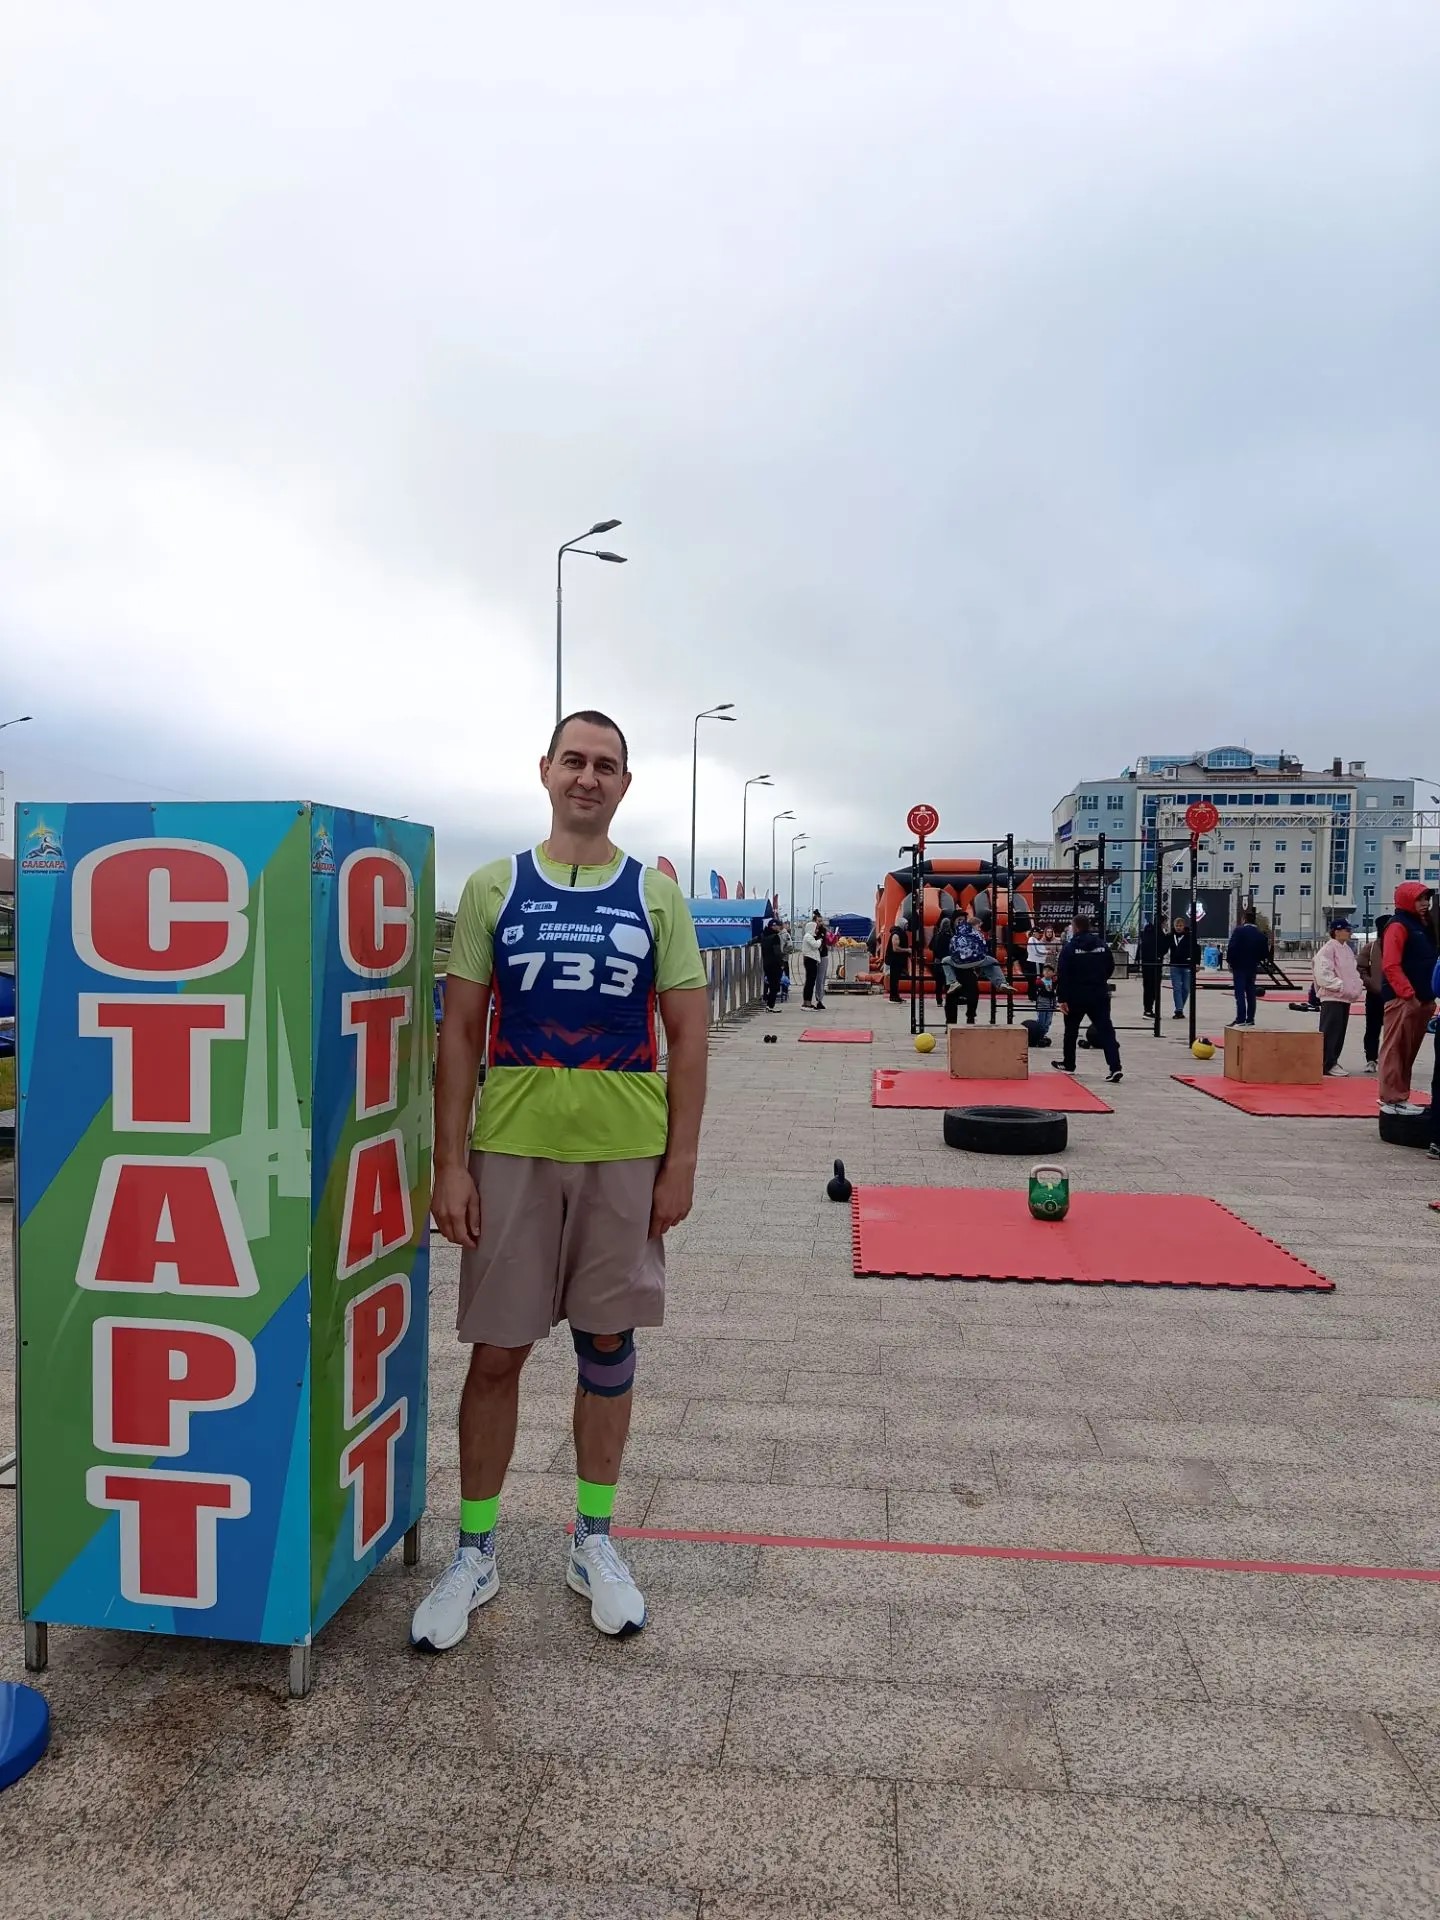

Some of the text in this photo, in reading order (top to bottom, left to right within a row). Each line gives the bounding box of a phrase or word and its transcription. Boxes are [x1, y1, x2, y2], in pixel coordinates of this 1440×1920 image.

[1039, 903, 1096, 914] СЕВЕРЫЙ
[536, 932, 605, 943] ХАРАКТЕР
[539, 922, 603, 933] СЕВЕРНЫЙ
[508, 952, 638, 997] 733
[338, 847, 414, 1561] СТАРТ
[72, 837, 260, 1609] СТАРТ
